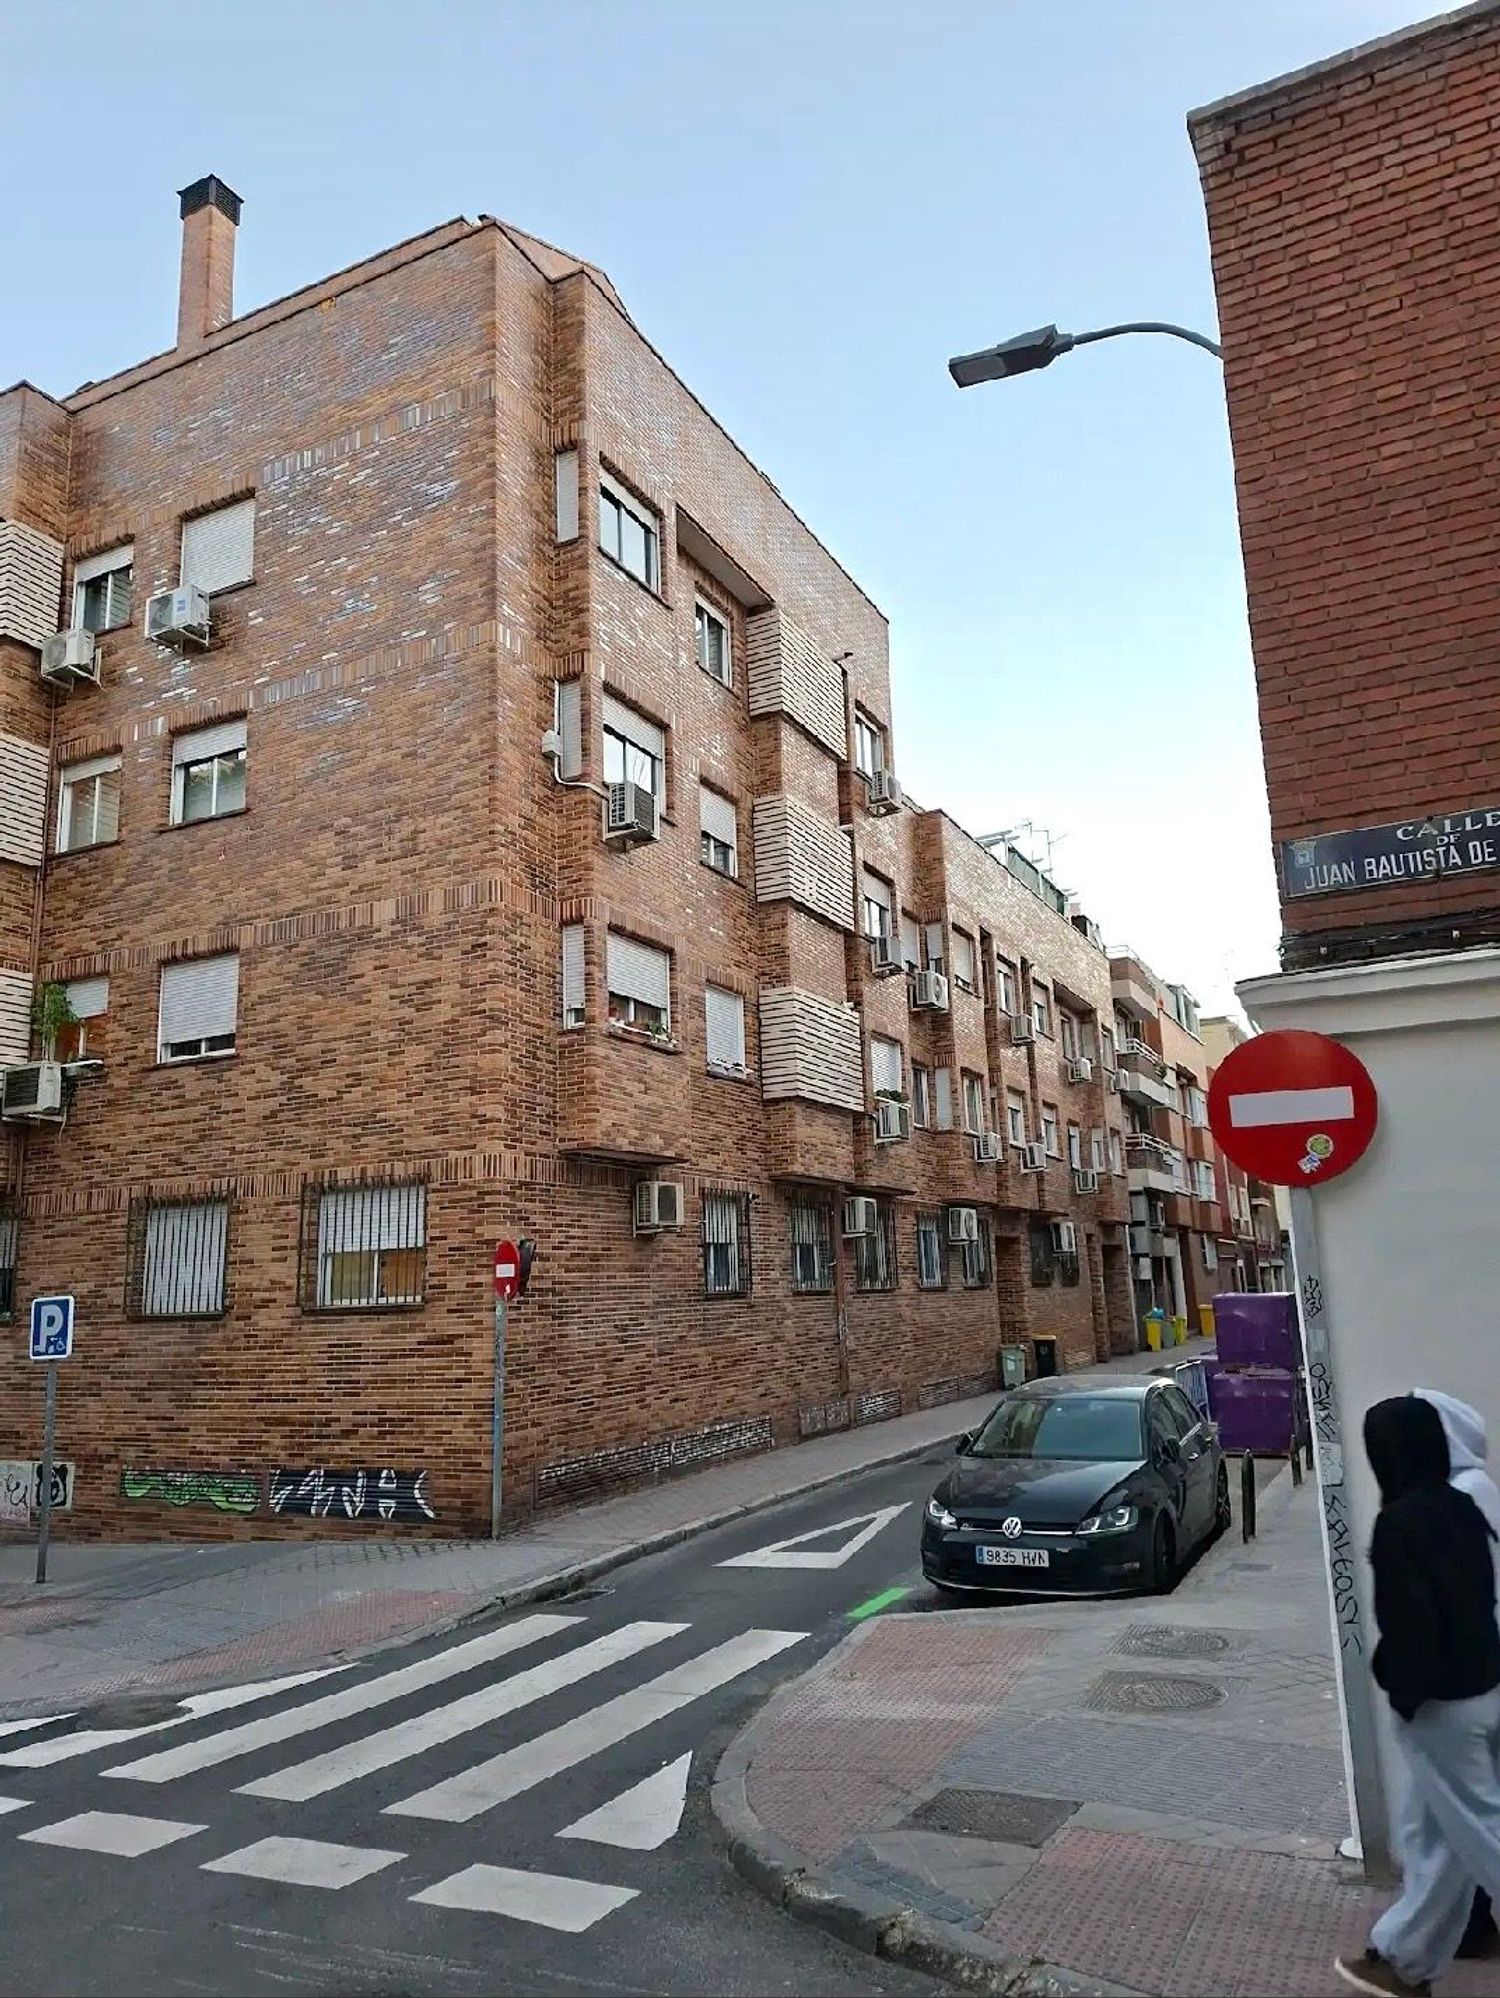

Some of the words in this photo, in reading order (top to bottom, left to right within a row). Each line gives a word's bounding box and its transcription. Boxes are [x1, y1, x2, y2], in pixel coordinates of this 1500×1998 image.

[1396, 811, 1500, 840] CALLE
[1436, 834, 1461, 846] DE
[1304, 860, 1356, 889] JUAN
[1364, 845, 1462, 880] BAUTISTA
[1468, 839, 1497, 865] DE
[986, 1550, 1016, 1564] 9835
[1021, 1551, 1046, 1566] HVN
